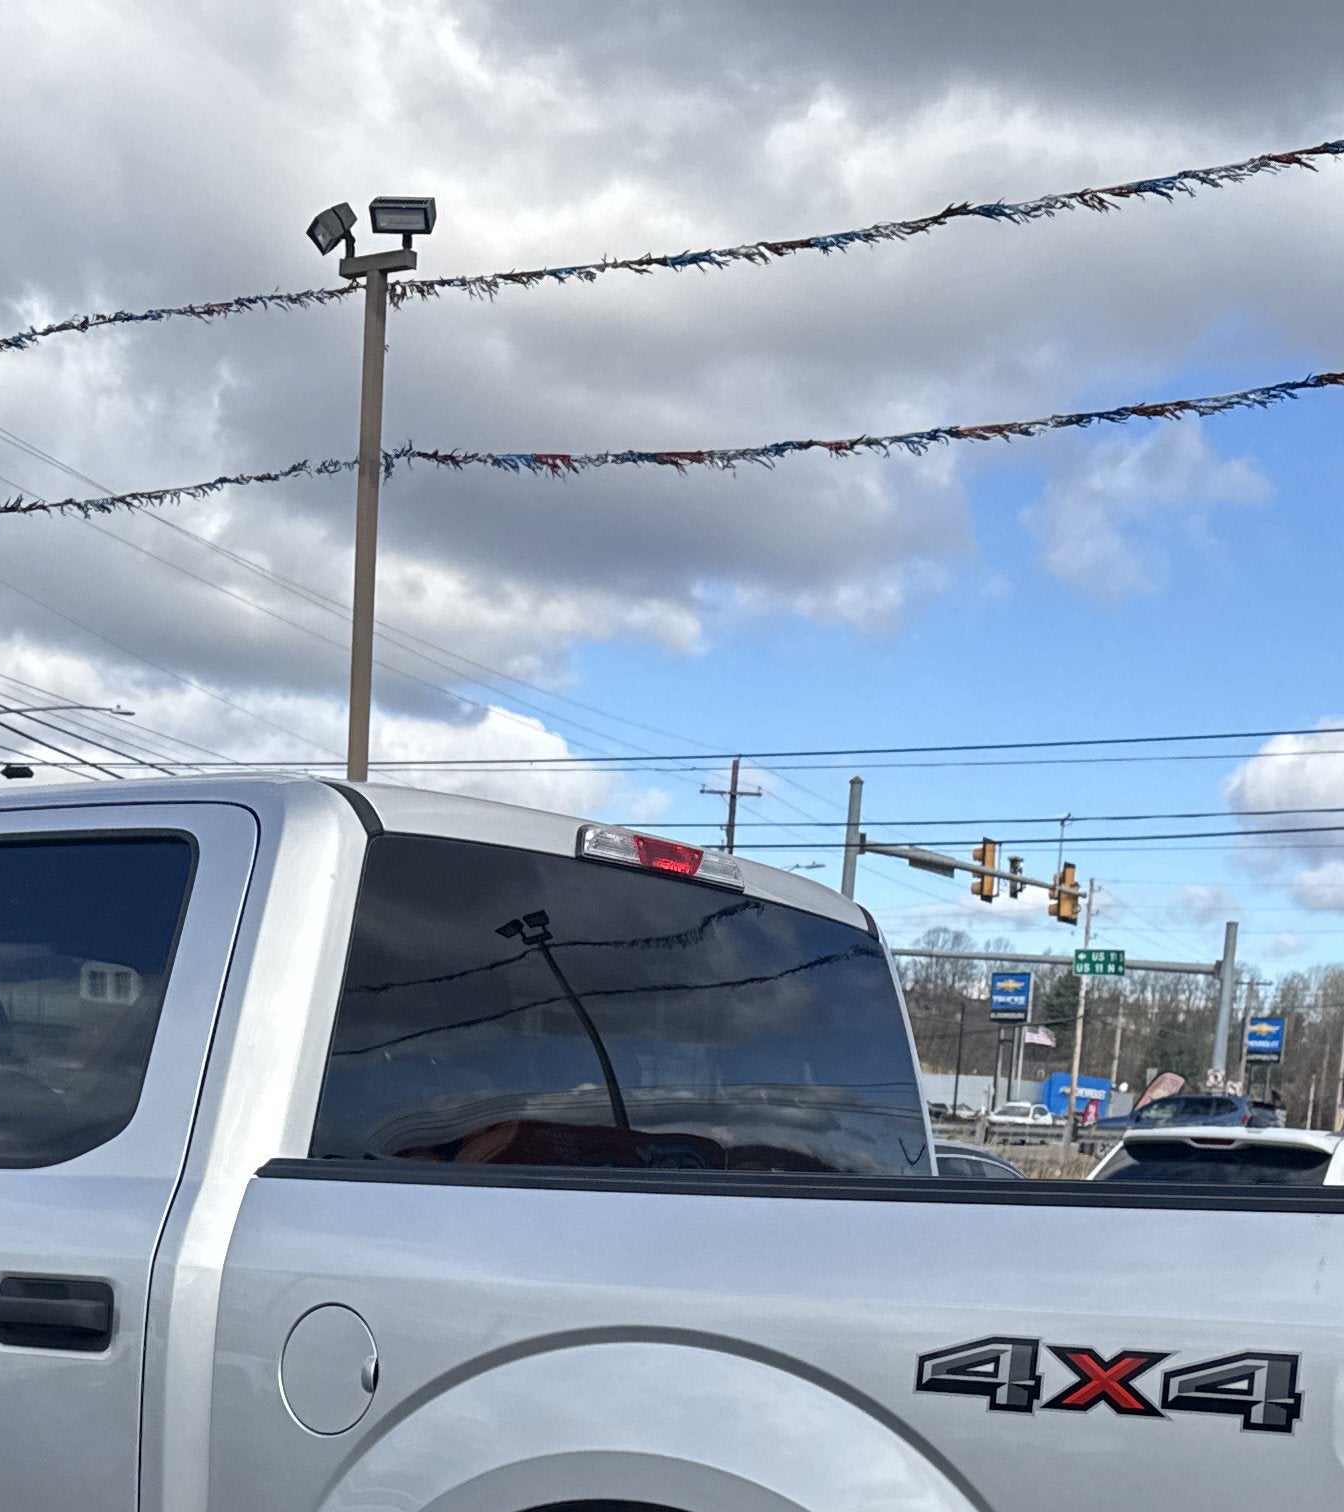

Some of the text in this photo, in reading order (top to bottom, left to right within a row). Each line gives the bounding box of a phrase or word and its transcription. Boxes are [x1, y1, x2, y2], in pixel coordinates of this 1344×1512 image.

[1091, 951, 1105, 961] US
[1076, 962, 1091, 973] US
[912, 1333, 1306, 1436] 4X4
